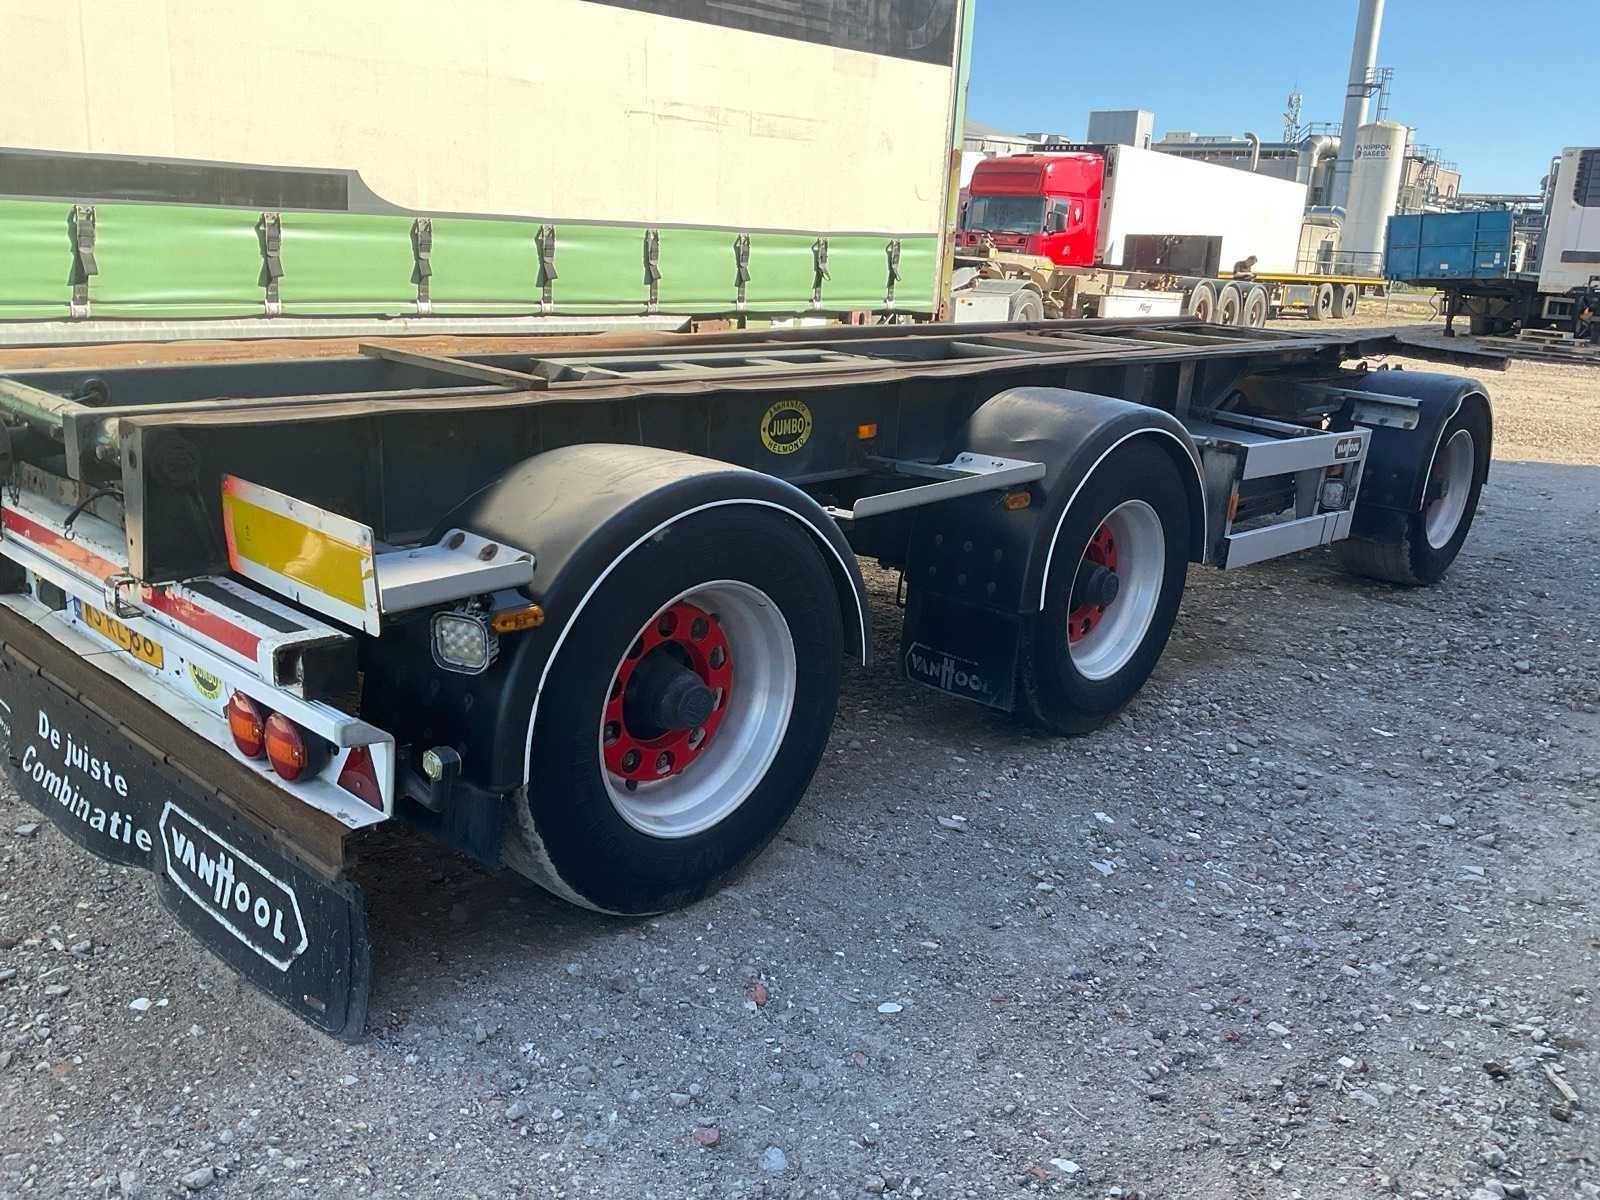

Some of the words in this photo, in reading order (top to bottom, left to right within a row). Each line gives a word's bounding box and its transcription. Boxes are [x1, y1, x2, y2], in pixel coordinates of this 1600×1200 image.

[1363, 143, 1392, 151] NIPPON
[770, 417, 805, 436] JUMBO
[767, 438, 804, 453] HELMOND
[38, 709, 61, 750] De
[63, 732, 128, 797] juiste
[21, 745, 153, 852] Combinatie
